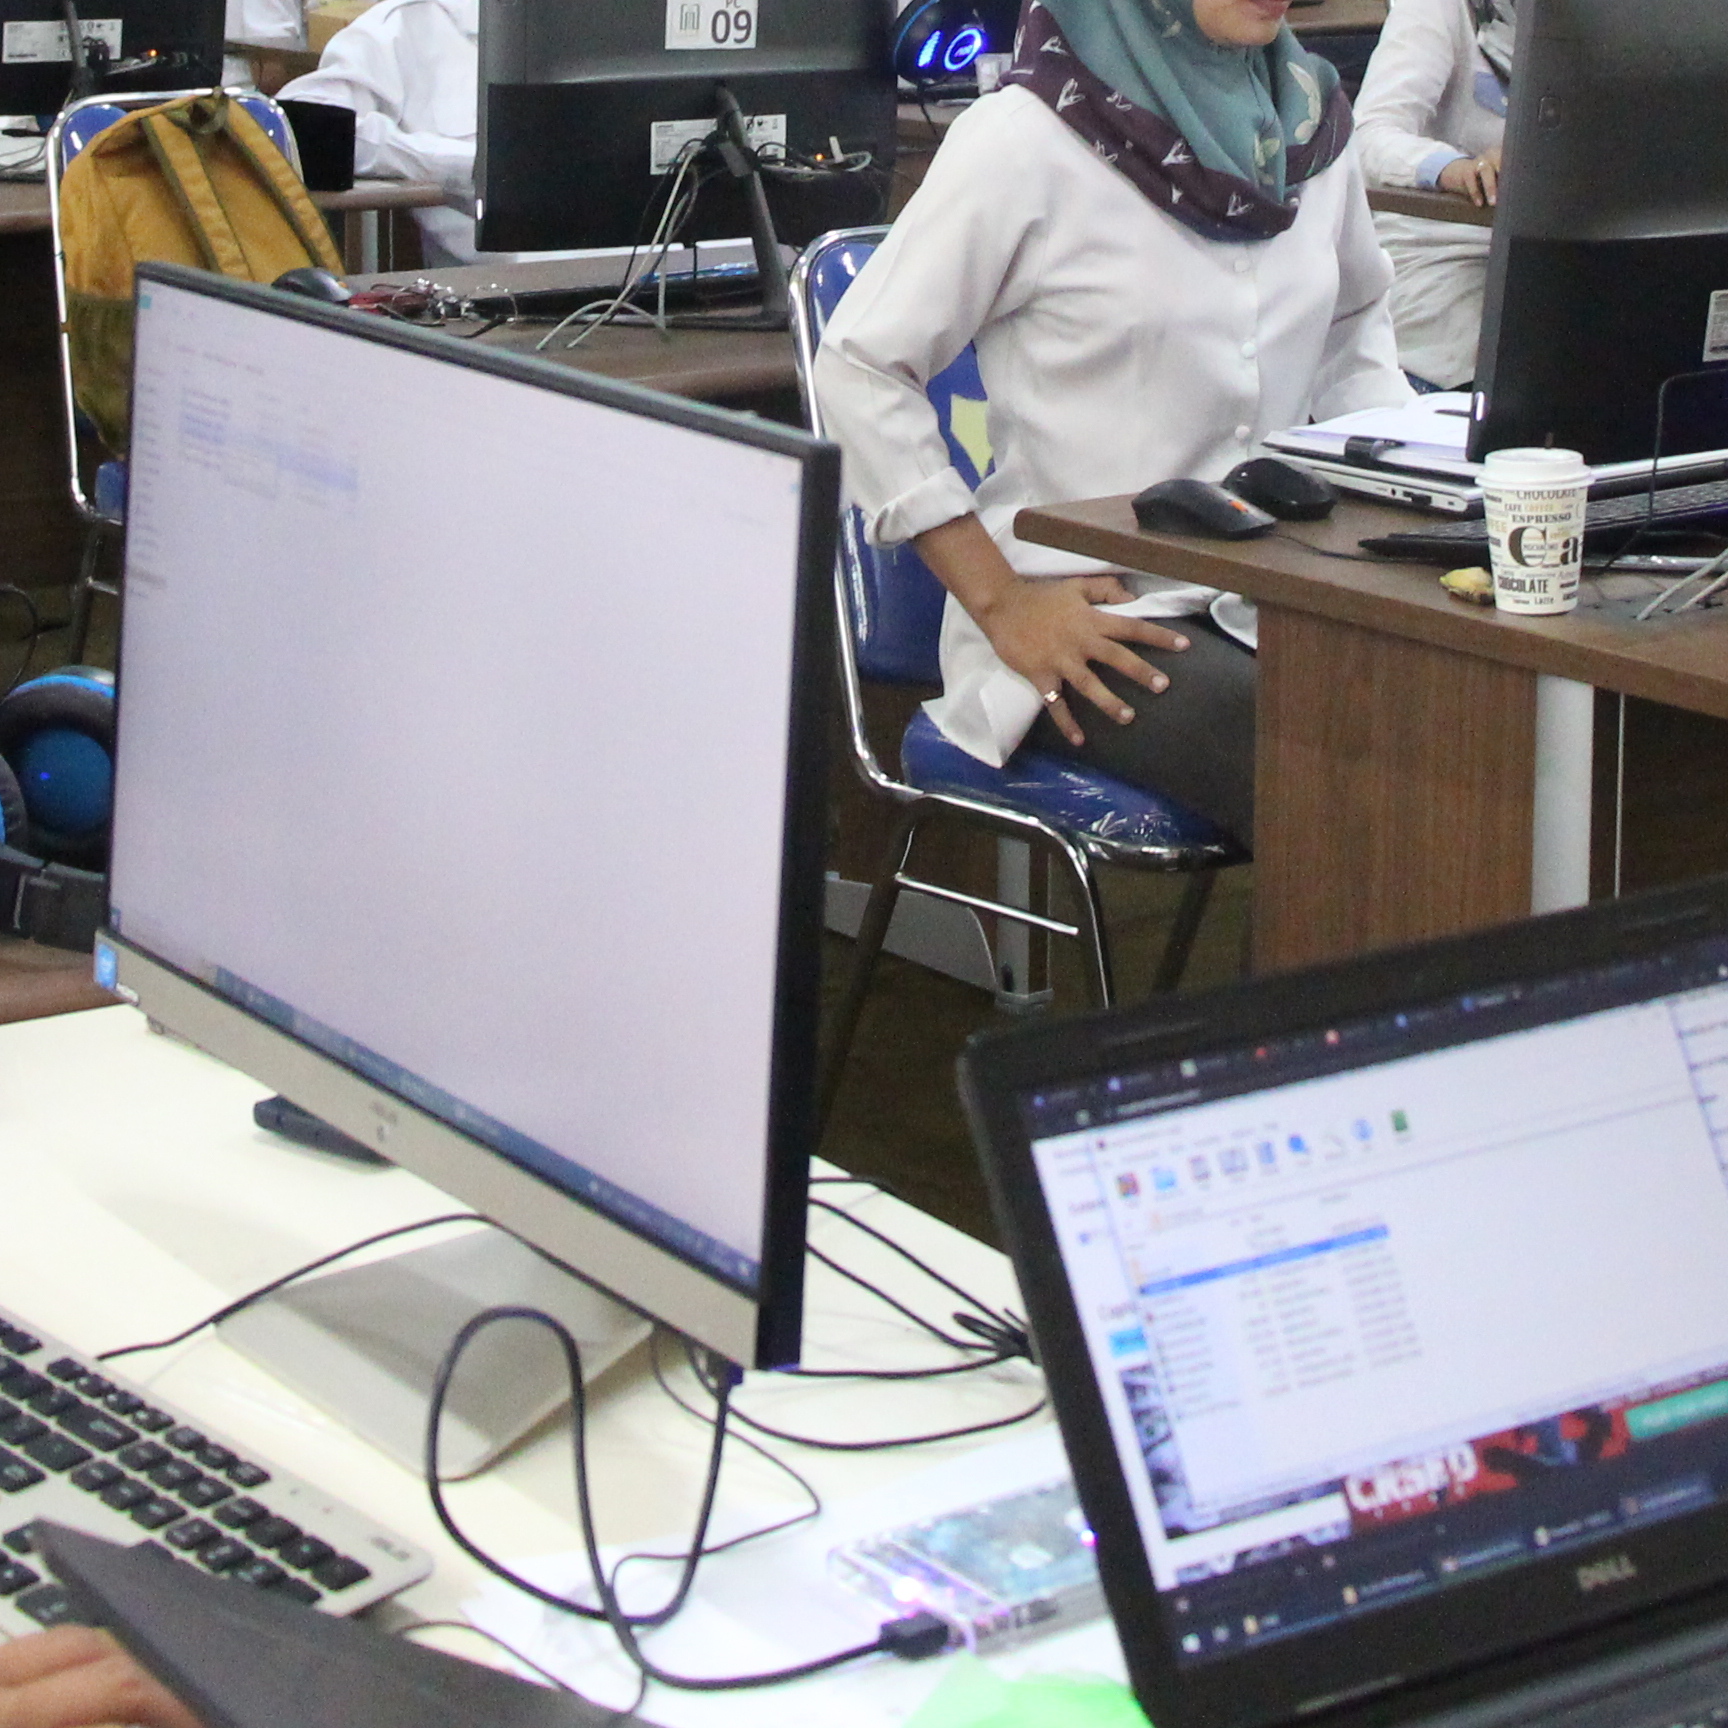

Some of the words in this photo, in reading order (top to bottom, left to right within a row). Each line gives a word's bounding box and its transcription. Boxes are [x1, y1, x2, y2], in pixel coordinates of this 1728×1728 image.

[711, 9, 752, 45] 09
[1511, 512, 1572, 524] ESPRESSO
[1576, 1554, 1637, 1593] DELL
